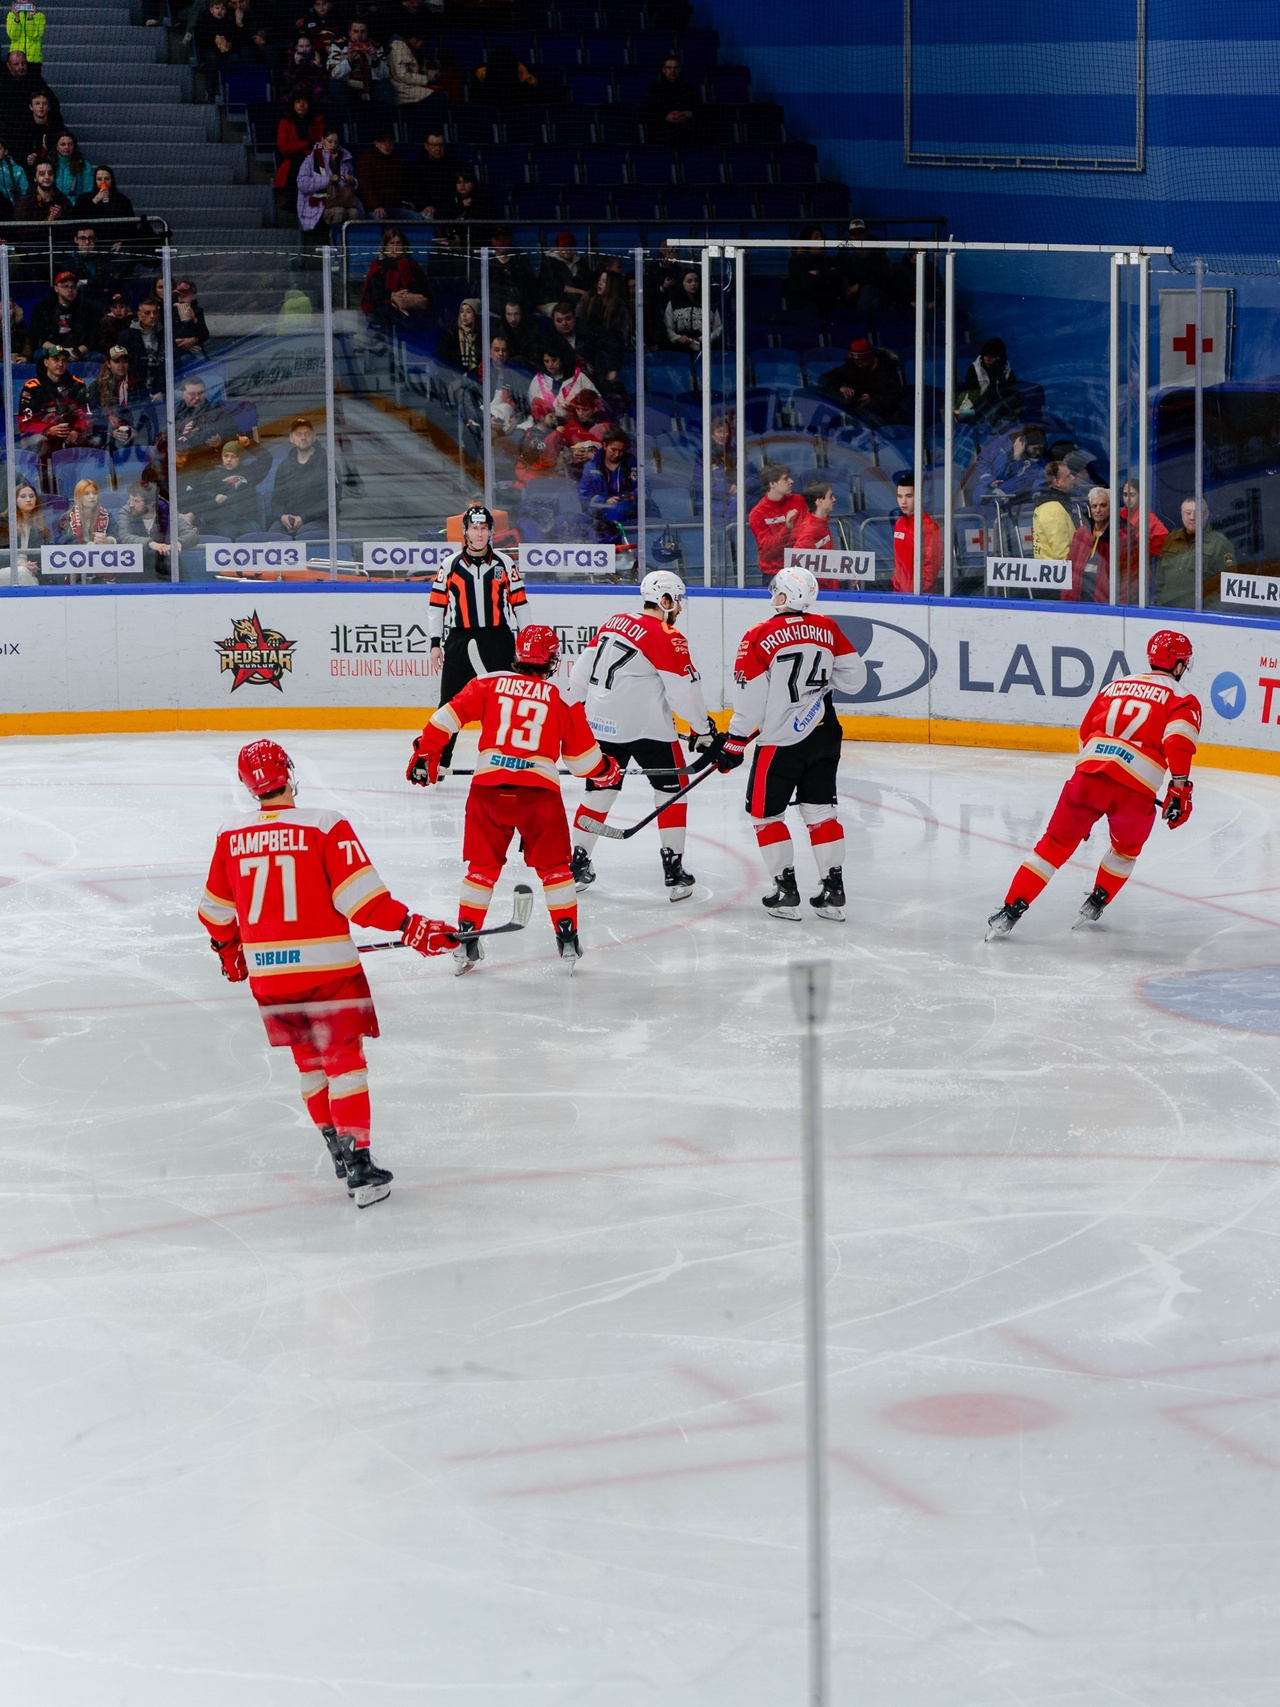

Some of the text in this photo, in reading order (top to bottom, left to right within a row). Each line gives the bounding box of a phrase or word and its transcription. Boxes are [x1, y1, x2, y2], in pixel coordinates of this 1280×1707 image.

[791, 553, 870, 575] KHL.RU
[992, 562, 1067, 583] KHL.RU
[605, 616, 648, 642] OKULOV
[760, 624, 834, 655] PROKHORKIN
[219, 649, 294, 673] REDSTAR
[330, 659, 440, 677] BEIJING KUNLUN
[589, 635, 639, 690] 17
[959, 640, 1131, 697] LADA
[1259, 656, 1278, 669] МЫ
[495, 677, 552, 702] DUSZAK
[776, 651, 829, 703] 74
[498, 697, 549, 751] 13
[1105, 698, 1151, 748] 12
[1095, 743, 1135, 764] SIBUR
[252, 768, 265, 781] 71
[229, 829, 309, 857] CAMPBELL
[337, 840, 367, 866] 71
[239, 854, 298, 925] 71
[255, 949, 301, 966] SIBUR
